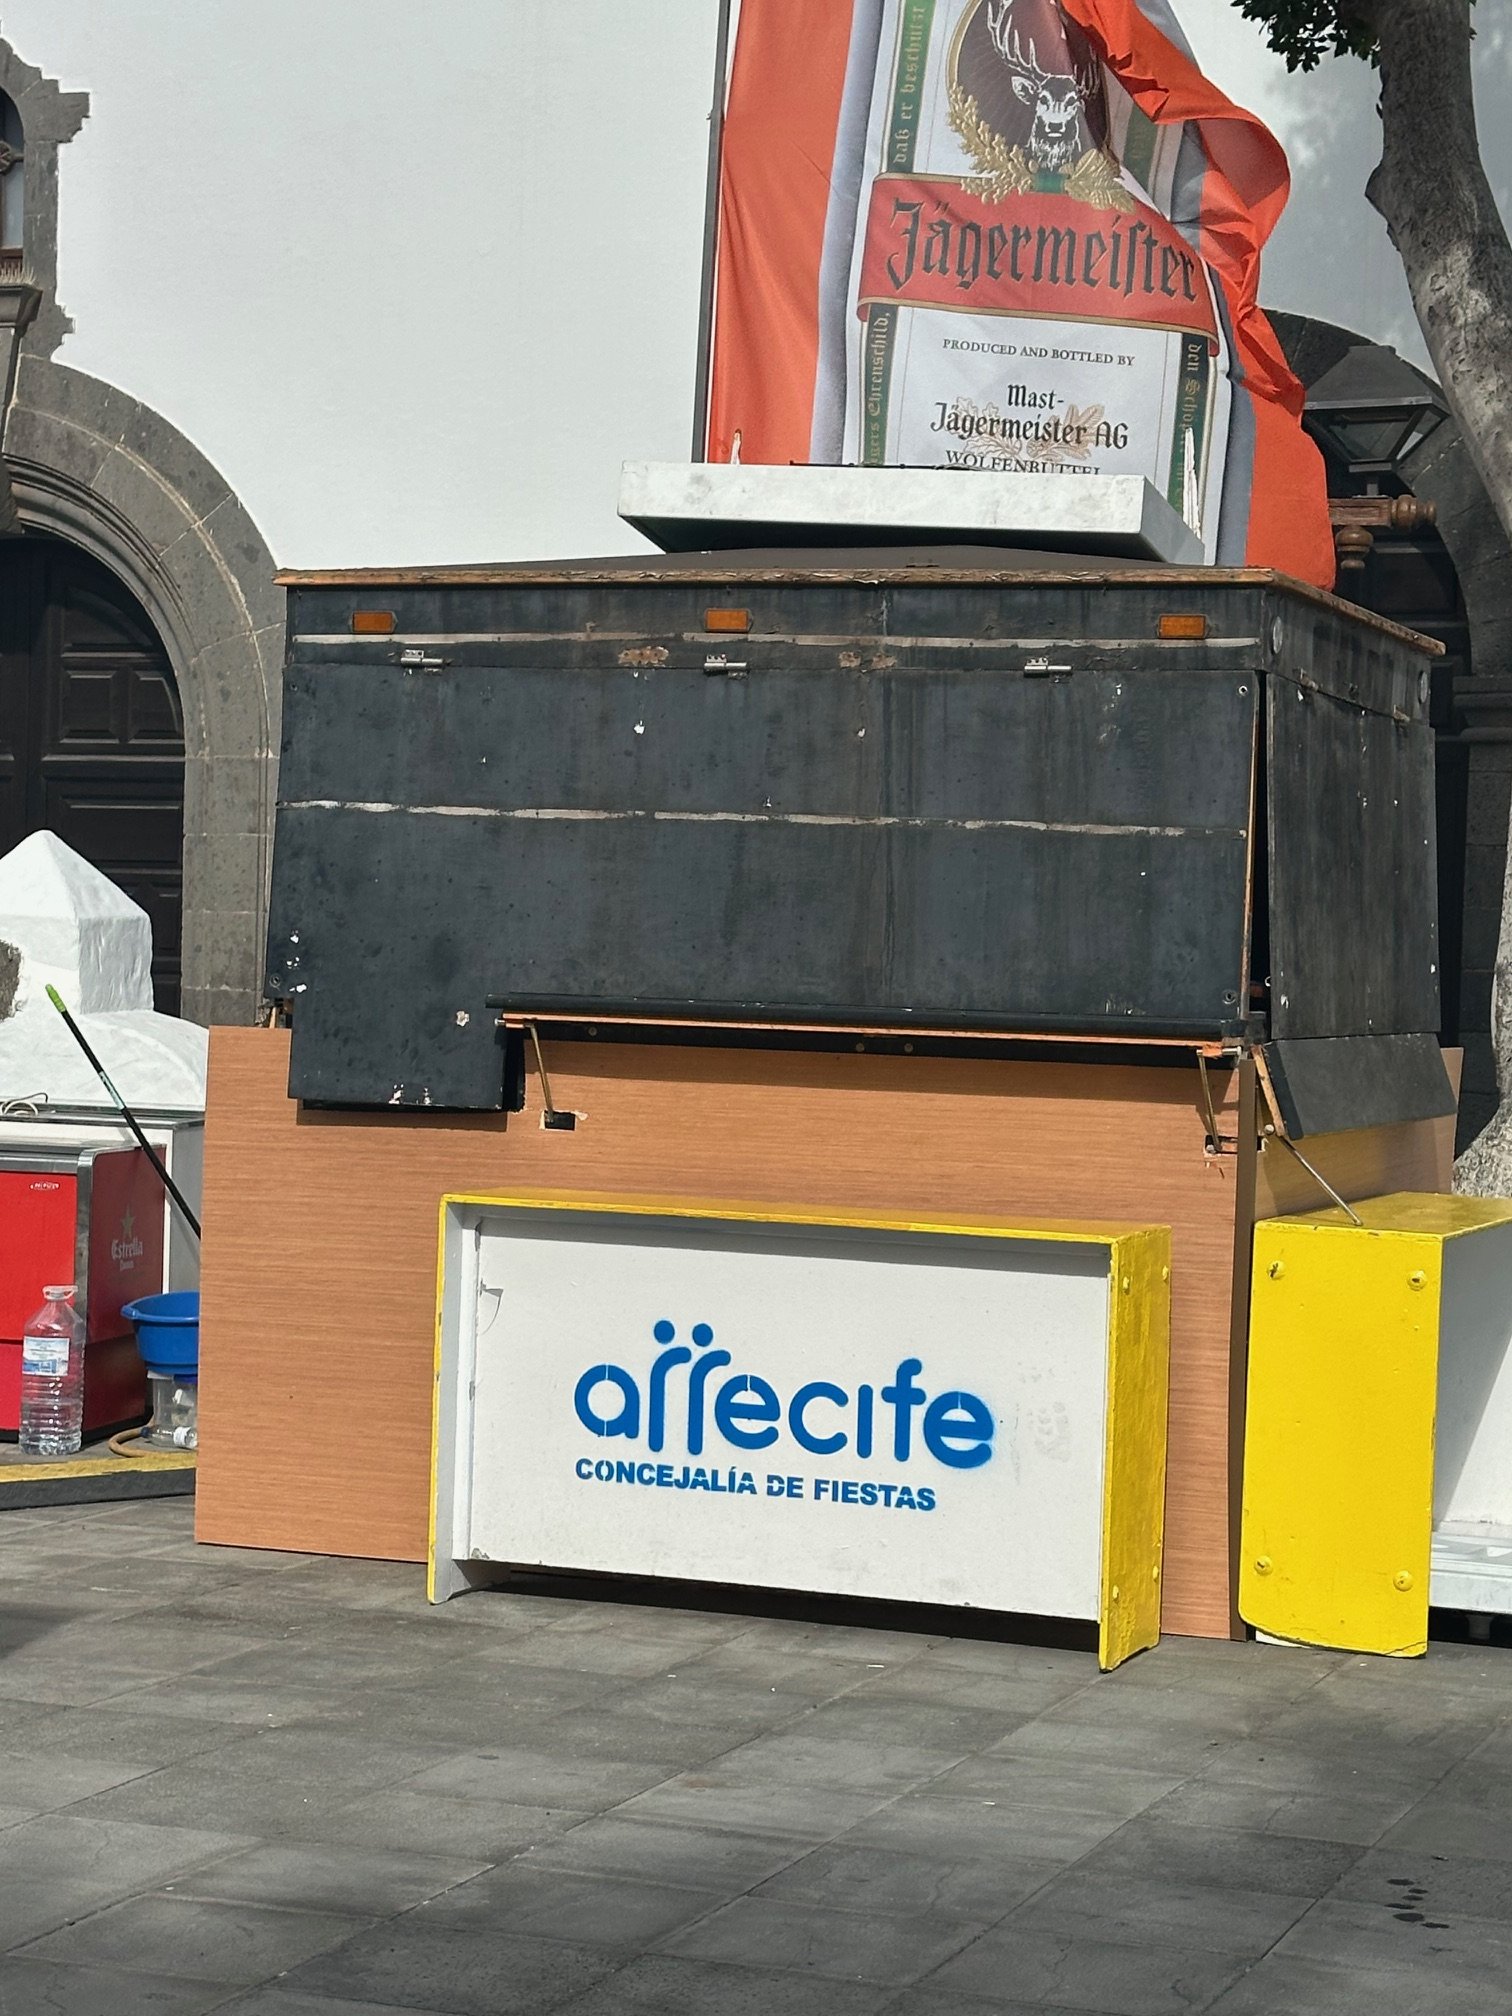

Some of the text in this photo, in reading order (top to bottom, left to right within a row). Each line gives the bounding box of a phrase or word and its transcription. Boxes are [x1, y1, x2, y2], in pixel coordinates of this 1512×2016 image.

[900, 102, 914, 121] er
[942, 338, 1136, 367] PRODUCED AND BOTTLED BY
[1186, 342, 1203, 371] den
[1006, 383, 1065, 410] Mast-
[929, 401, 1130, 450] Jägermeister AG
[573, 1319, 995, 1470] arrecife
[574, 1457, 937, 1512] CONCEJALÍA DE FIESTAS
